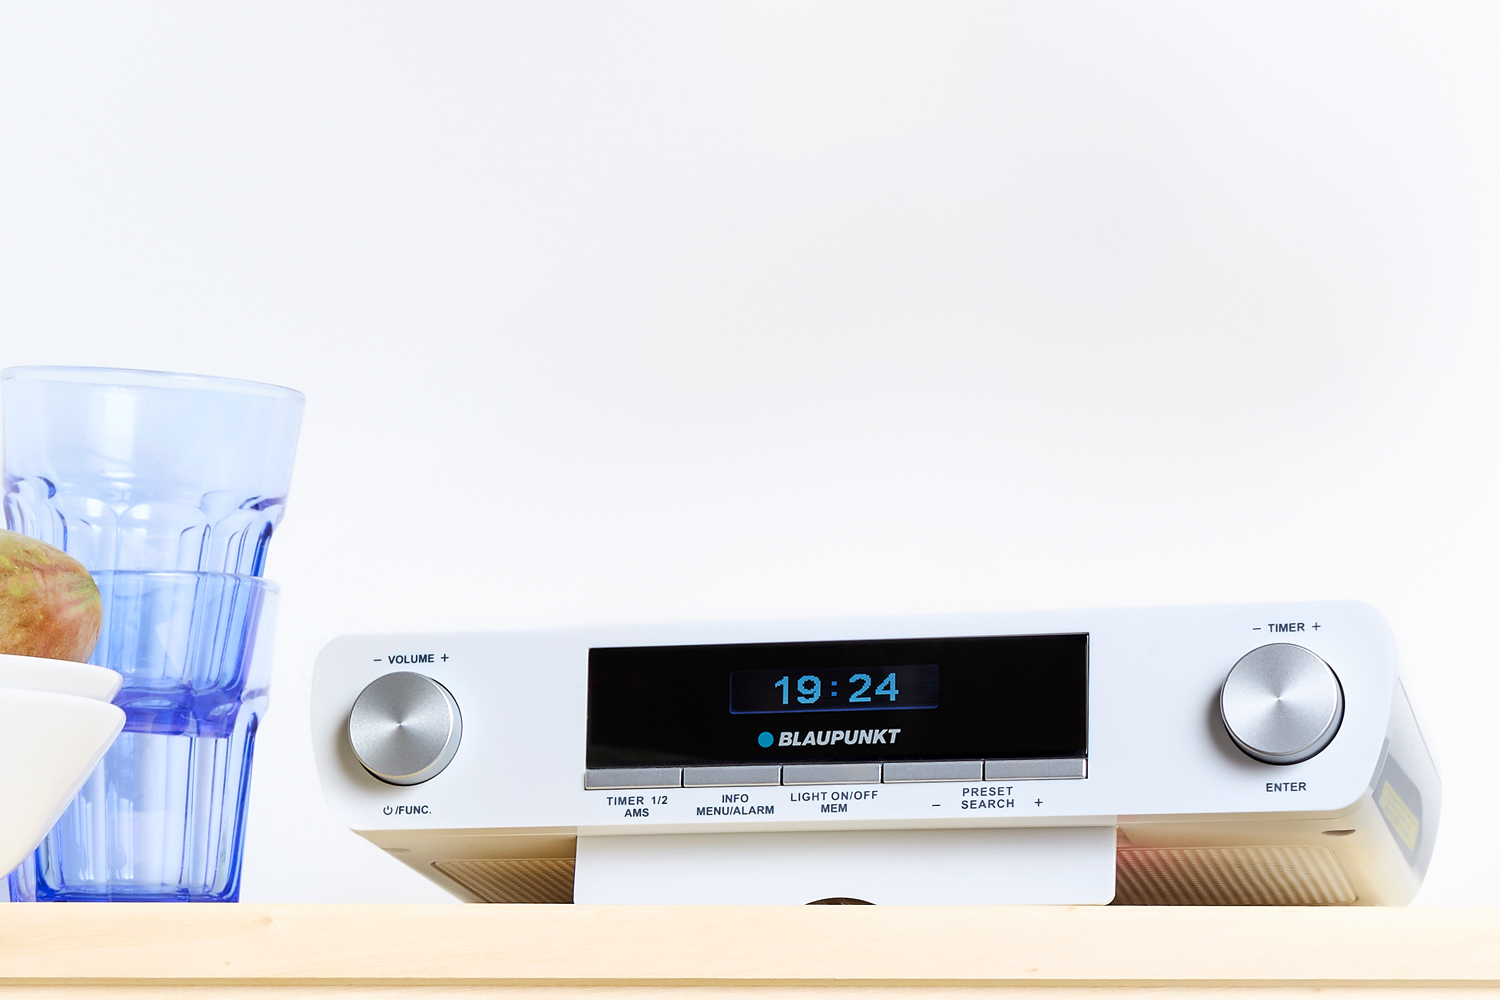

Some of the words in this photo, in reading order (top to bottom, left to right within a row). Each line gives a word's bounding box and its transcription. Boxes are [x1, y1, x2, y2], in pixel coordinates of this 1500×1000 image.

[1267, 622, 1306, 633] TIMER
[387, 653, 435, 665] VOLUME
[778, 728, 902, 747] BLAUPUNKT
[962, 786, 1014, 797] PRESET
[1265, 781, 1307, 793] ENTER
[606, 795, 645, 806] TIMER
[651, 795, 668, 805] 1/2
[721, 793, 749, 804] INFO
[790, 792, 828, 802] LIGHT
[830, 790, 879, 801] ON/OFF
[820, 803, 848, 813] MEM
[961, 798, 1015, 810] SEARCH
[624, 807, 650, 818] AMS
[696, 804, 776, 816] MENU/ALARM
